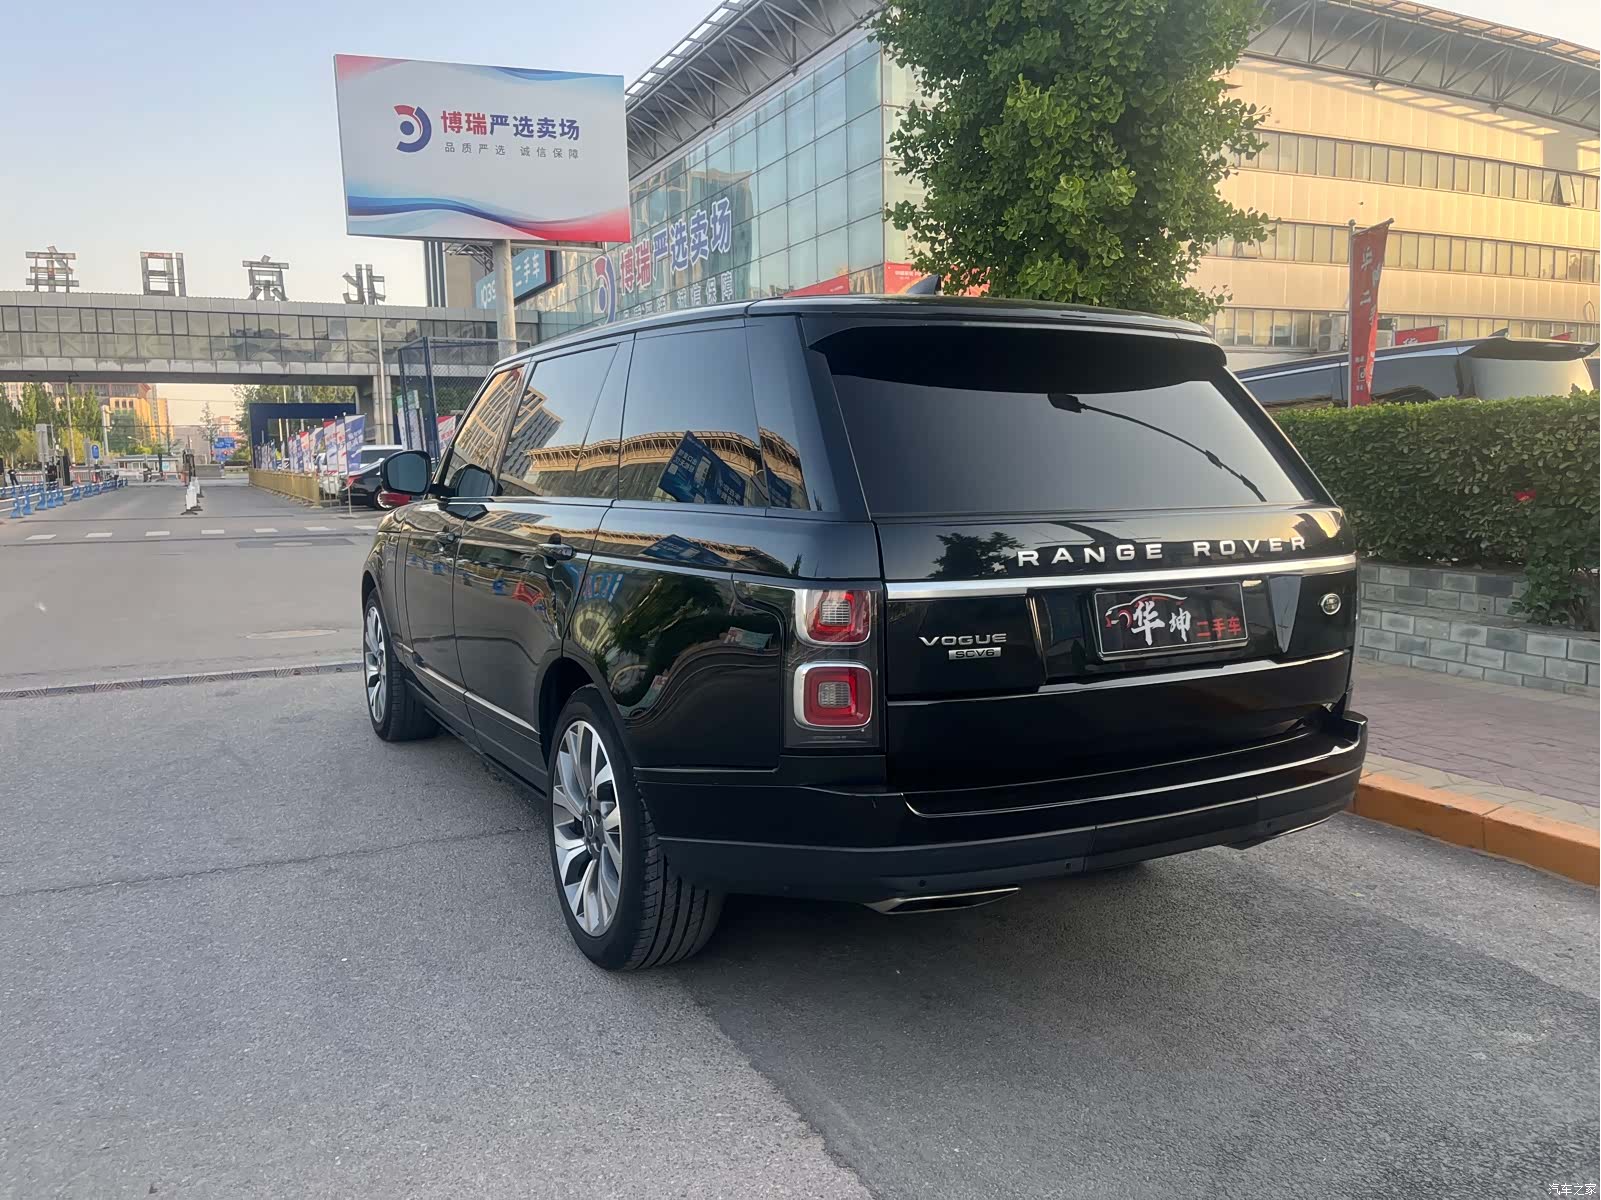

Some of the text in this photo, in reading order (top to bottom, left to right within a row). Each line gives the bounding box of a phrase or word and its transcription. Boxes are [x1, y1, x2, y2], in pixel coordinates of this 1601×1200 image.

[441, 110, 580, 141] 博瑞严选卖场
[444, 142, 579, 160] 品质严选 诚信保障
[620, 197, 732, 297] 博瑞严选卖场
[515, 252, 540, 287] 二手车
[1018, 536, 1306, 567] RANGE ROVER
[1131, 600, 1242, 646] 华坤 二手车
[919, 633, 1007, 647] VOGUE
[955, 648, 995, 659] SCV6
